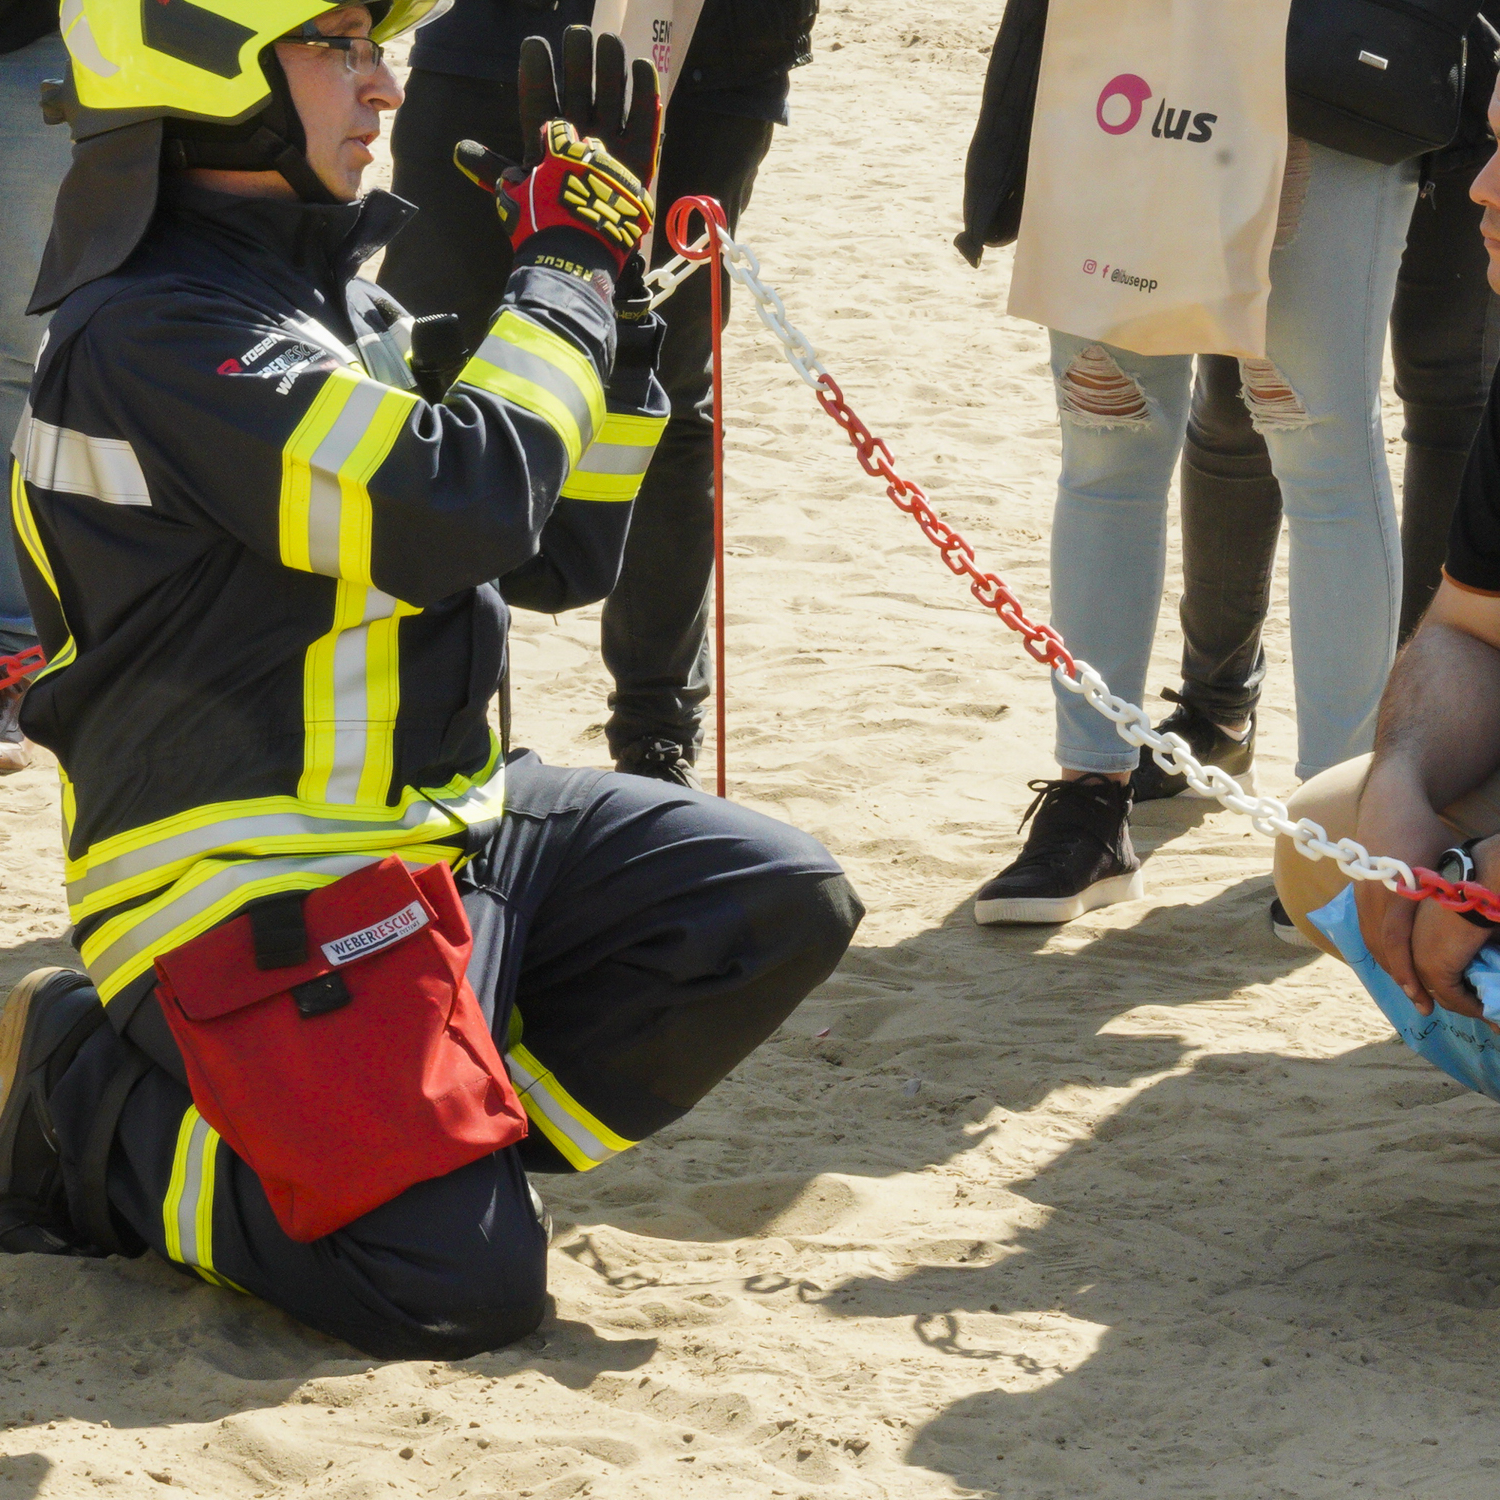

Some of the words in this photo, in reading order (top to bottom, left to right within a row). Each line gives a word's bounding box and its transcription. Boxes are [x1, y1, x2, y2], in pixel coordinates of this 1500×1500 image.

[652, 43, 671, 74] SEG
[534, 254, 594, 282] RESCUE
[241, 332, 287, 367] rosen
[399, 920, 421, 936] SYSTEMS
